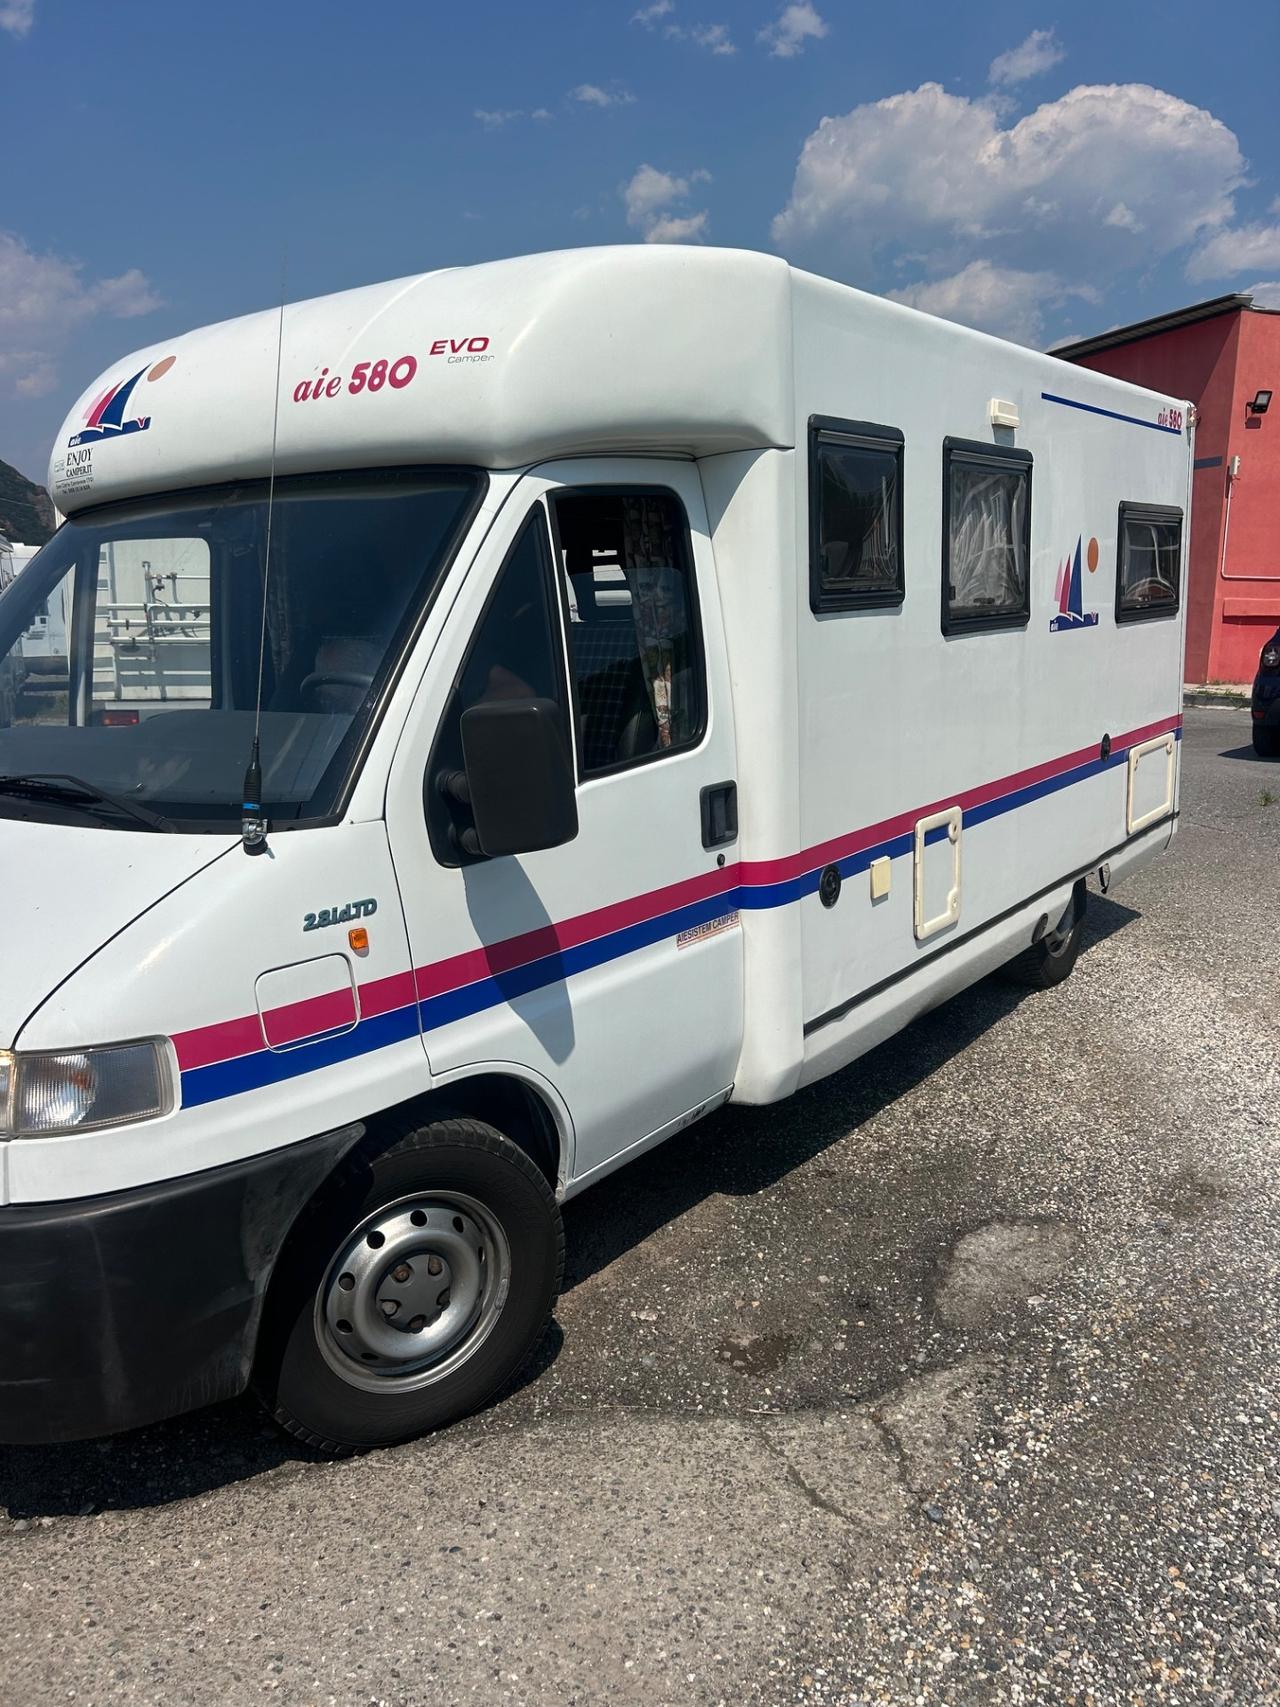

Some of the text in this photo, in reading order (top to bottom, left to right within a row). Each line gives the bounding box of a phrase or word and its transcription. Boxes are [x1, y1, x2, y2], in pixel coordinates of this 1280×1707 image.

[430, 337, 490, 355] EVO
[447, 354, 495, 364] Camper
[293, 355, 417, 402] aie 580
[1169, 409, 1182, 430] 580
[66, 448, 93, 466] ENJOY
[712, 911, 739, 929] CAMPER
